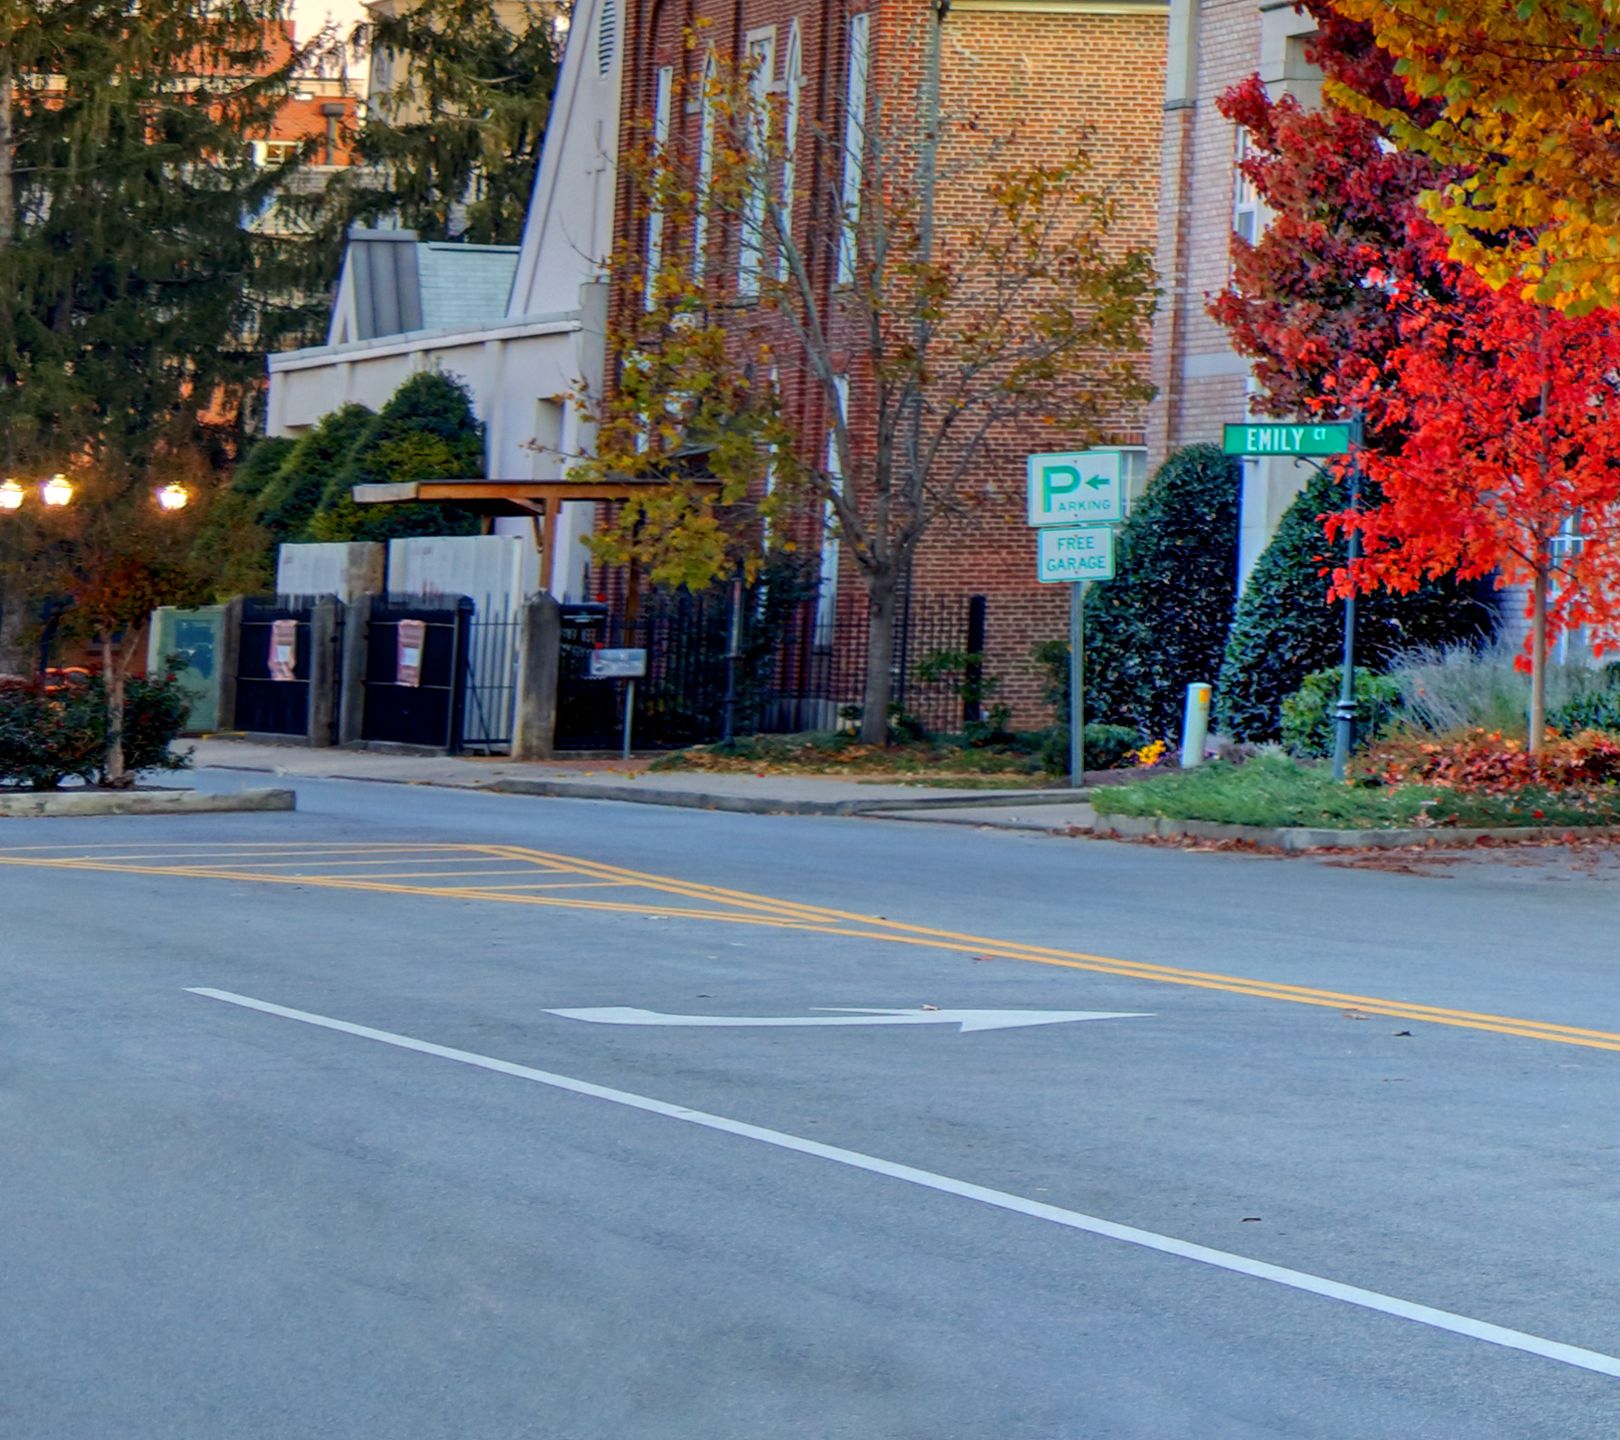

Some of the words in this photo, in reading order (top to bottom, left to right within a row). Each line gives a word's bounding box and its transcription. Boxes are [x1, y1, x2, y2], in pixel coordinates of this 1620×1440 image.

[1246, 427, 1304, 451] EMILY
[1056, 535, 1095, 551] FREE
[1046, 555, 1106, 572] GARAGE
